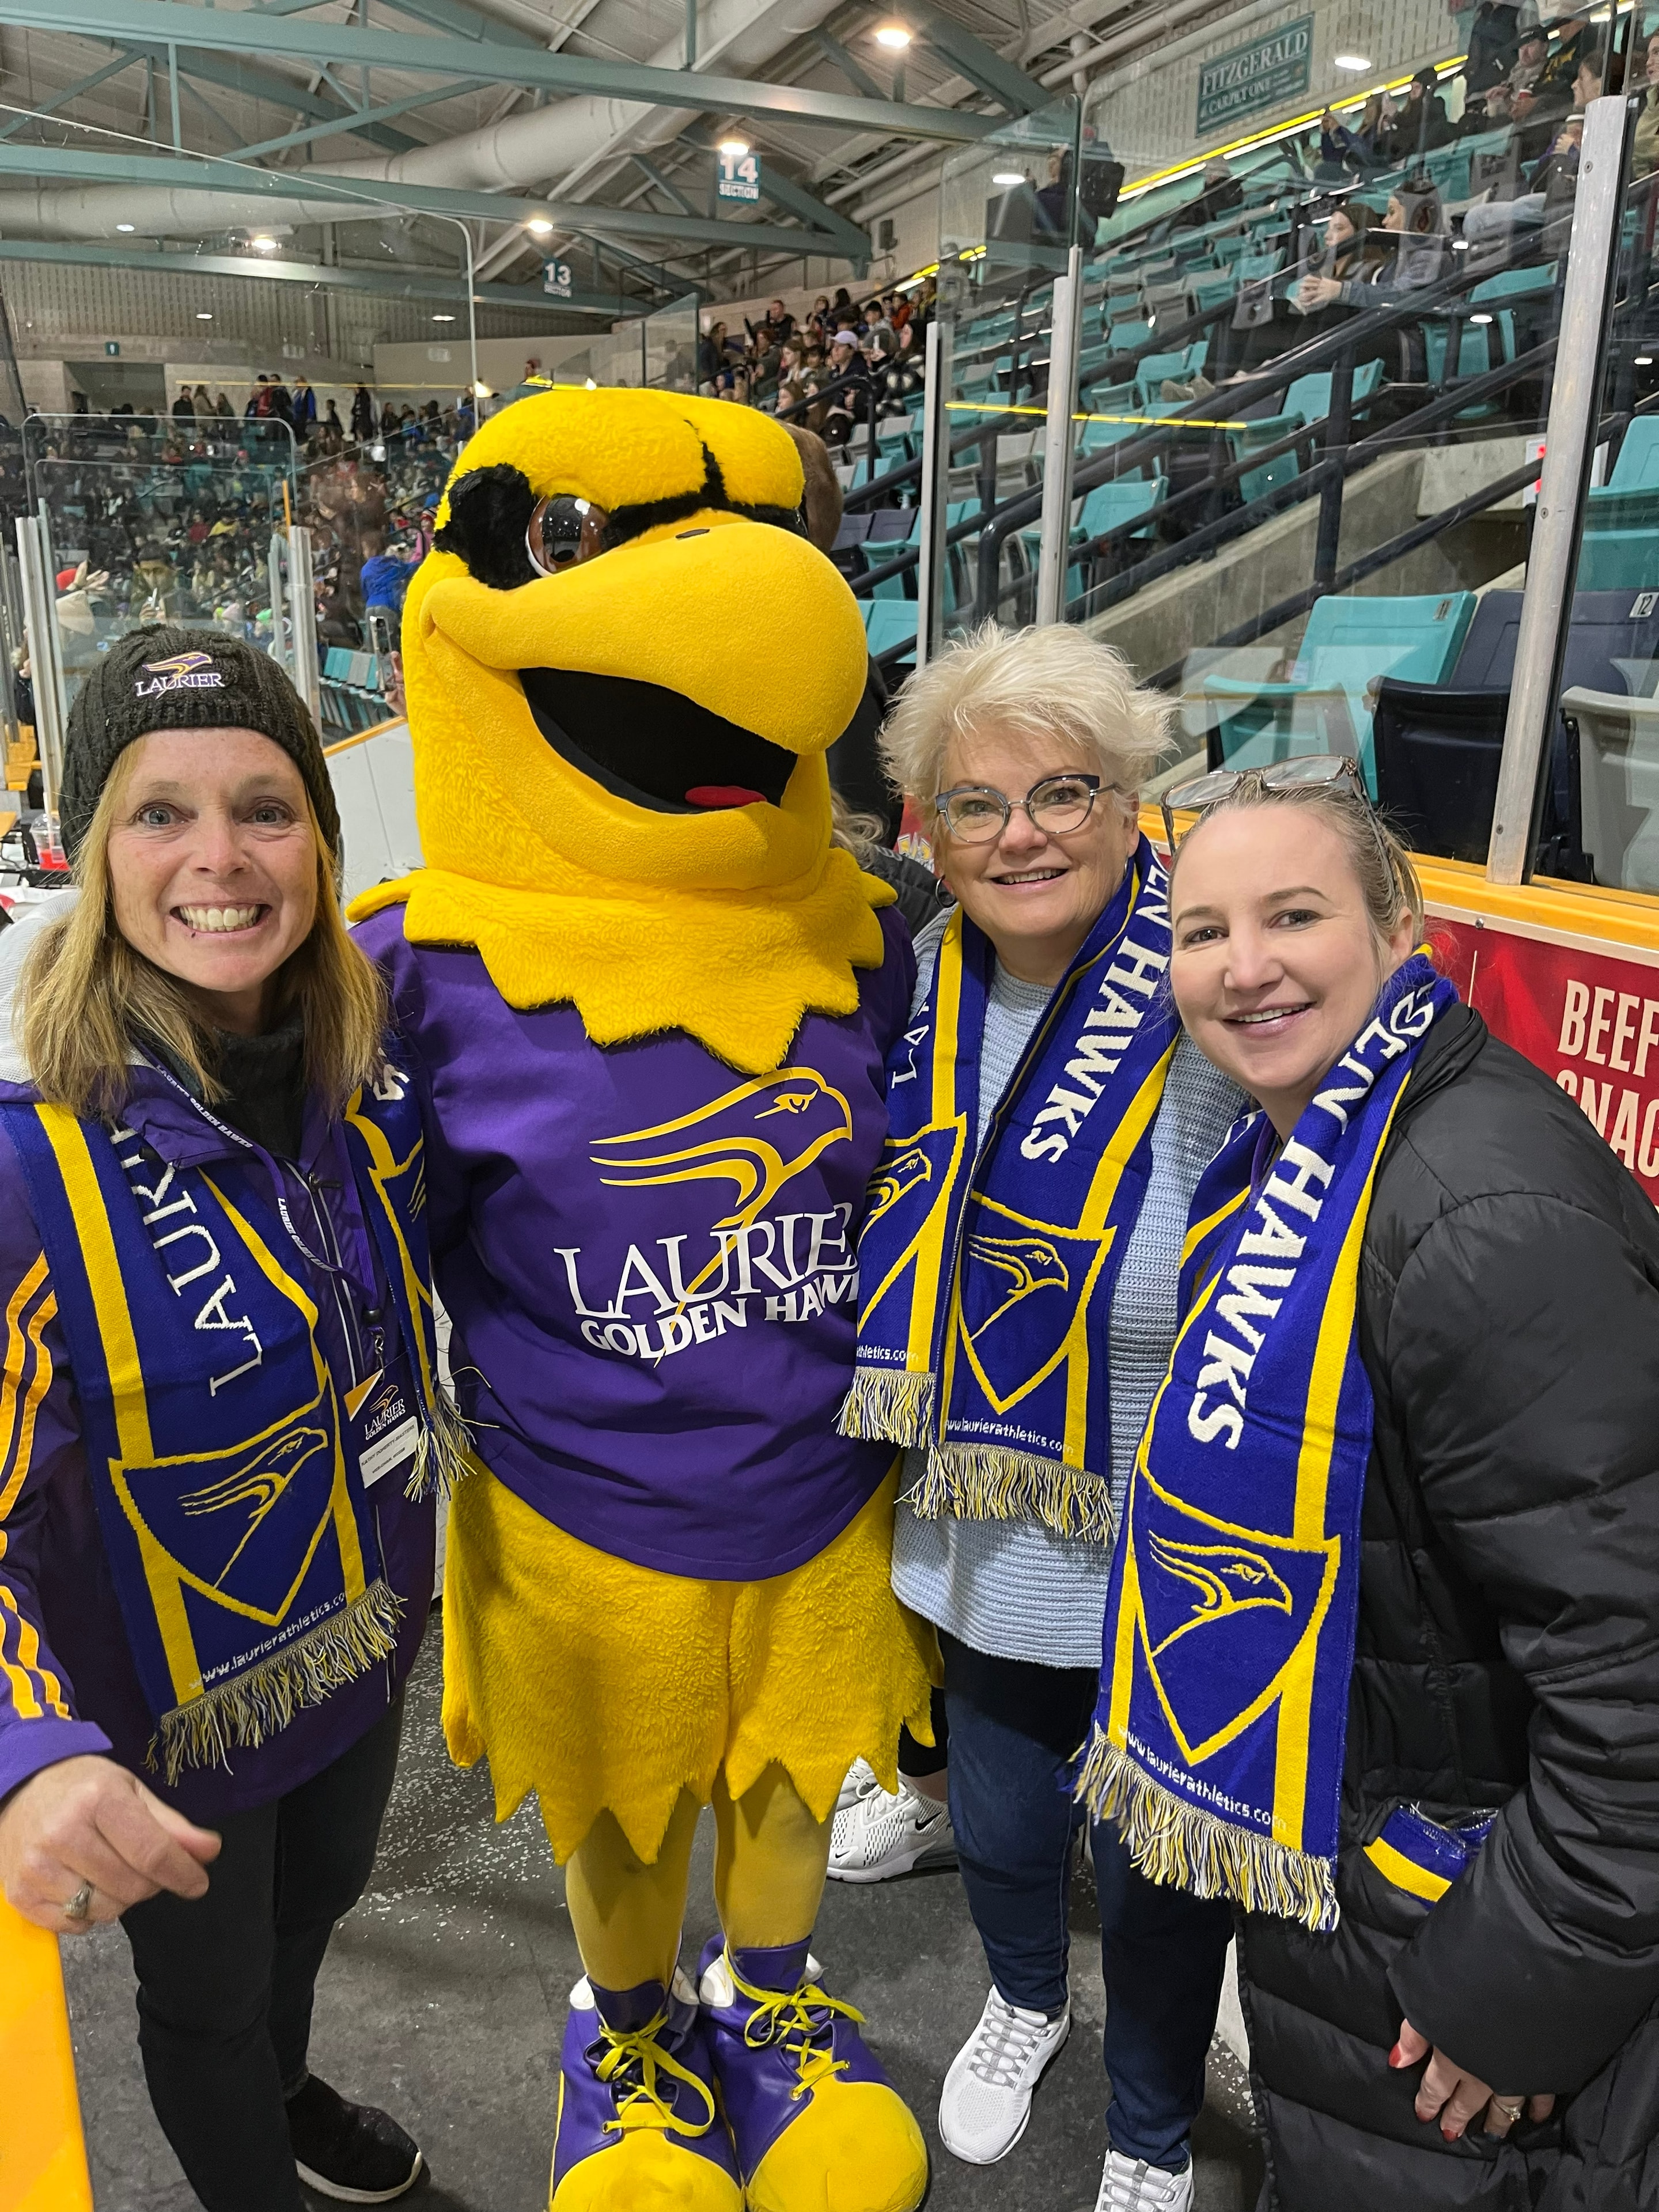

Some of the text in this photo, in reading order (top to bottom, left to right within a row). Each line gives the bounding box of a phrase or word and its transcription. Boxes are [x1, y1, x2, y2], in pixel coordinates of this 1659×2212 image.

[1202, 31, 1308, 96] FITZGERALD
[720, 156, 758, 183] 14
[719, 184, 759, 199] SECTION
[545, 262, 571, 286] 13
[1637, 594, 1653, 615] 12
[135, 672, 226, 697] LAURIER
[1557, 979, 1659, 1078] BEEF
[1021, 936, 1170, 1163] HAWKS
[1187, 1136, 1335, 1451] HAWKS
[581, 1298, 748, 1360] GOLDEN
[365, 1398, 406, 1435] LAURIER
[365, 1407, 406, 1441] GOLDEN HAWKS
